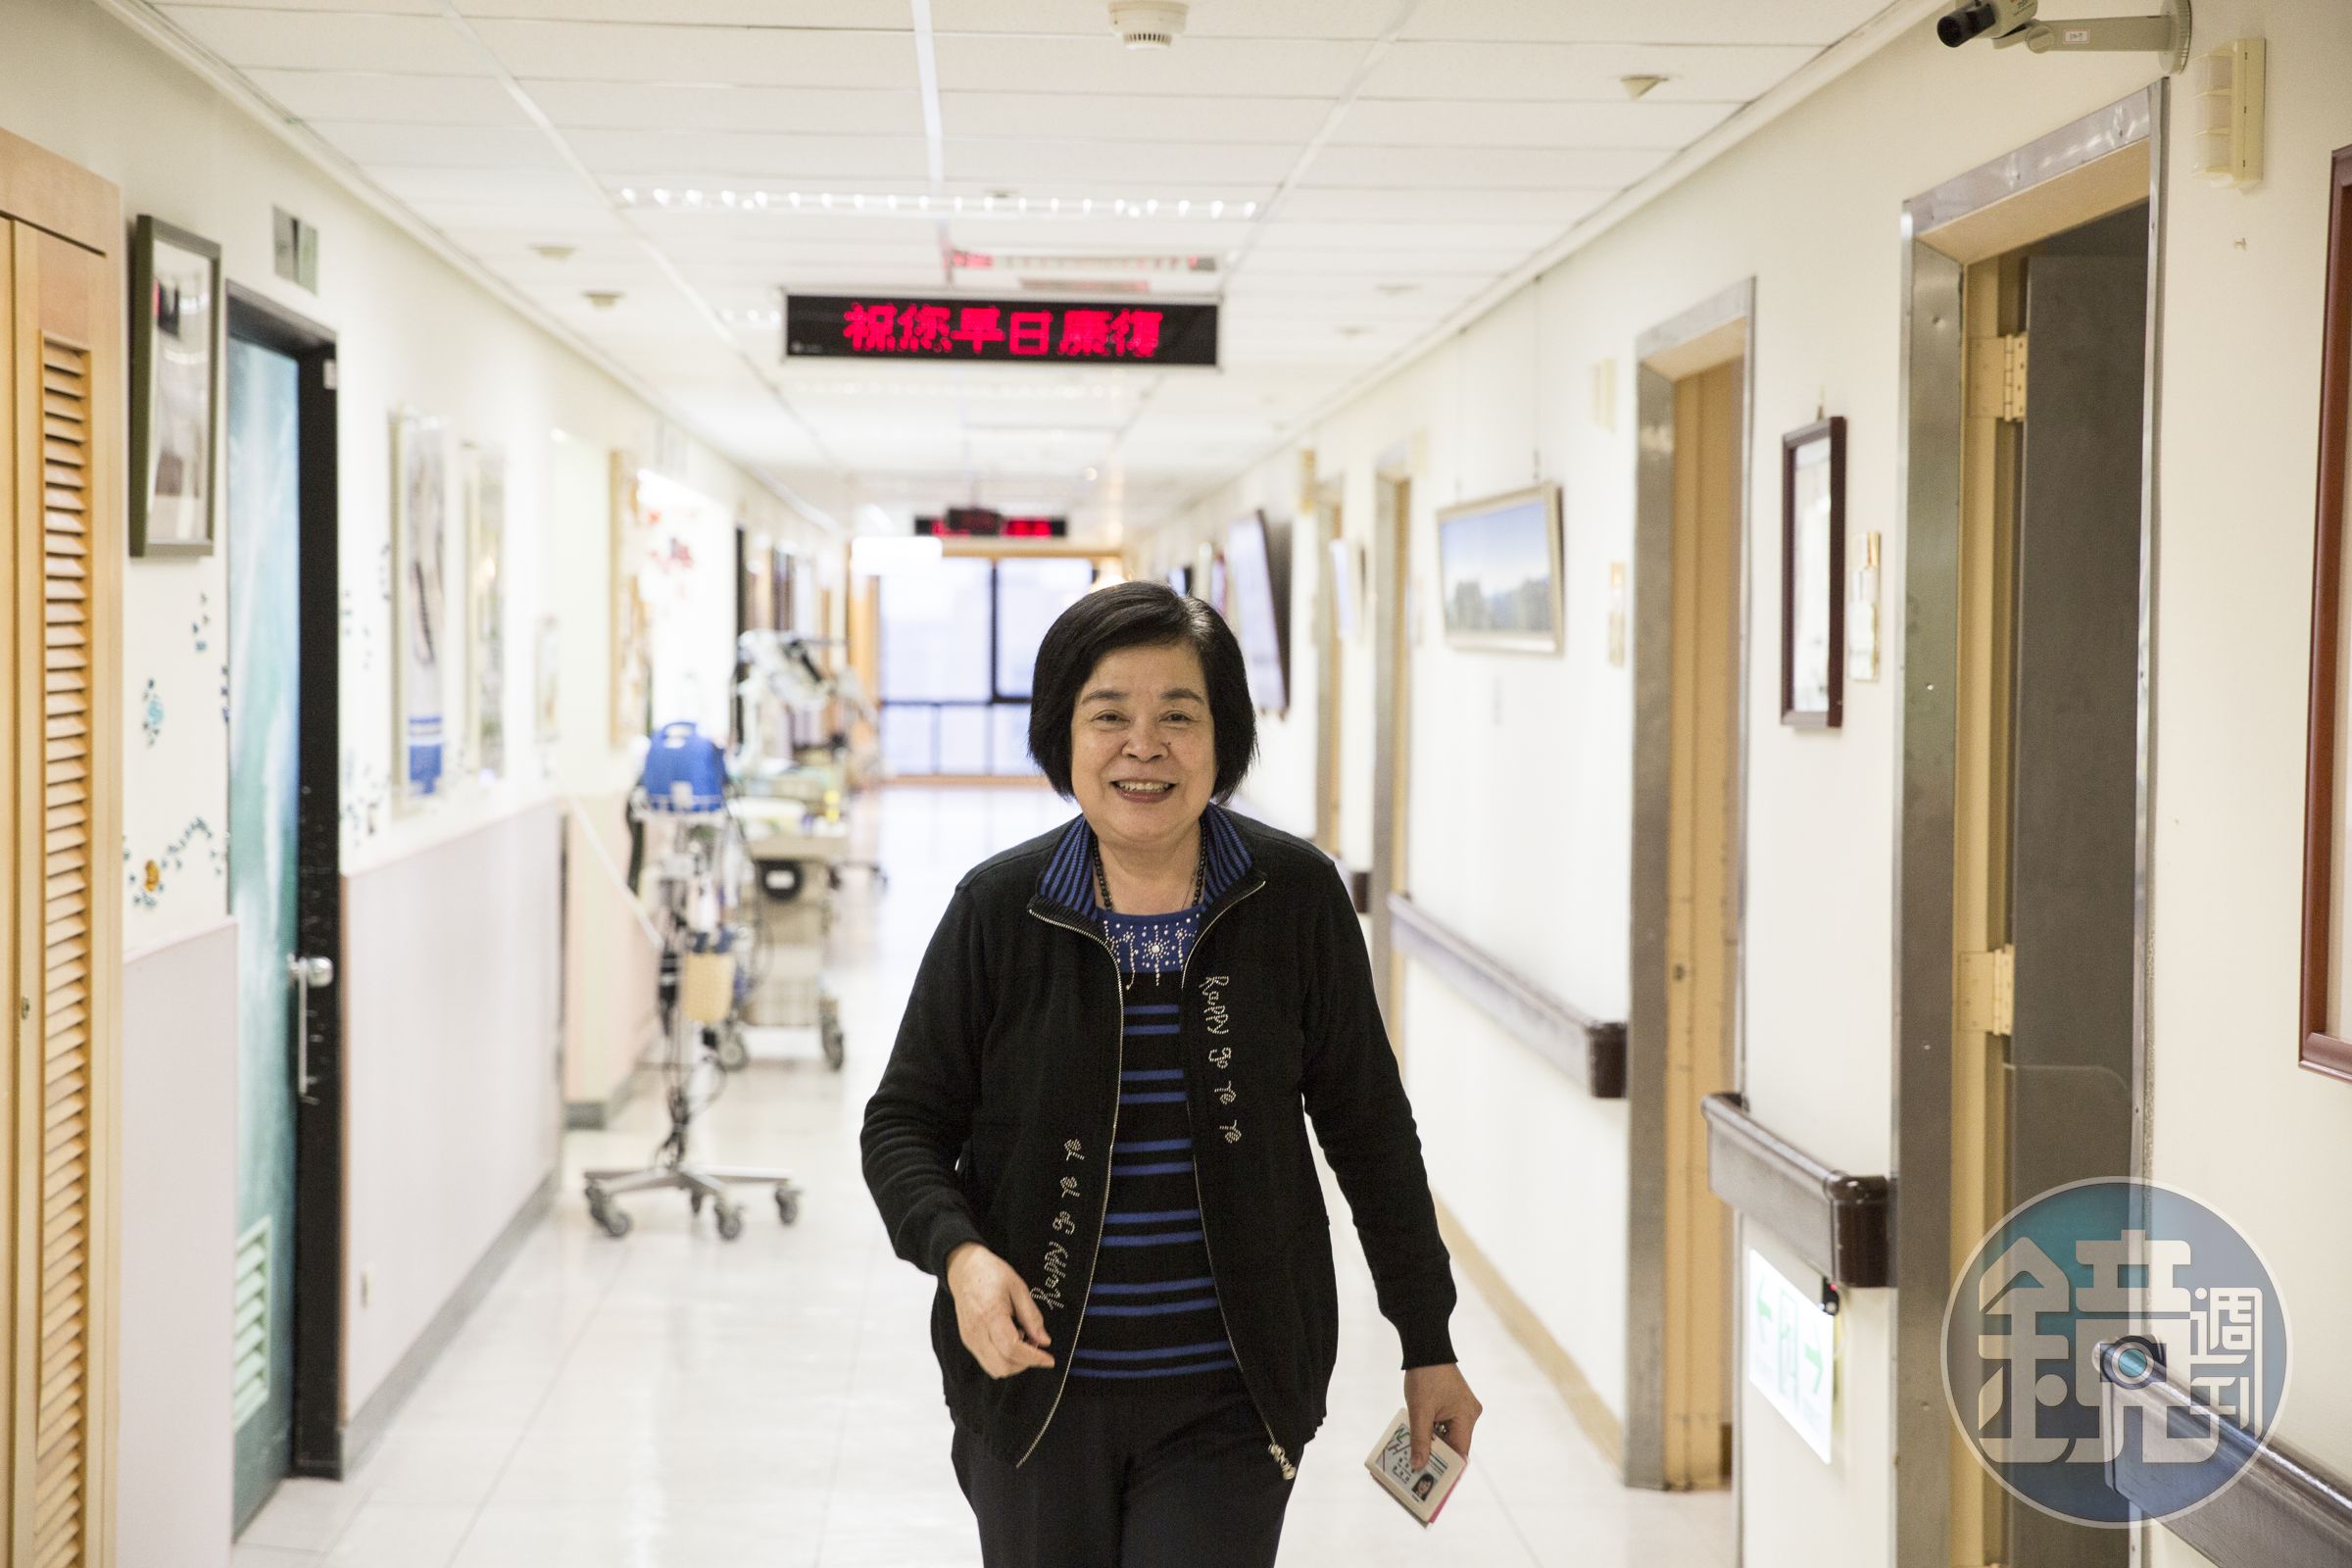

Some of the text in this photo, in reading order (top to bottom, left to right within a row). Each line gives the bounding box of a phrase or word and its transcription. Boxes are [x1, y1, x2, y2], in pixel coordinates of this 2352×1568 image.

[844, 303, 1163, 357] 祝您早日康復
